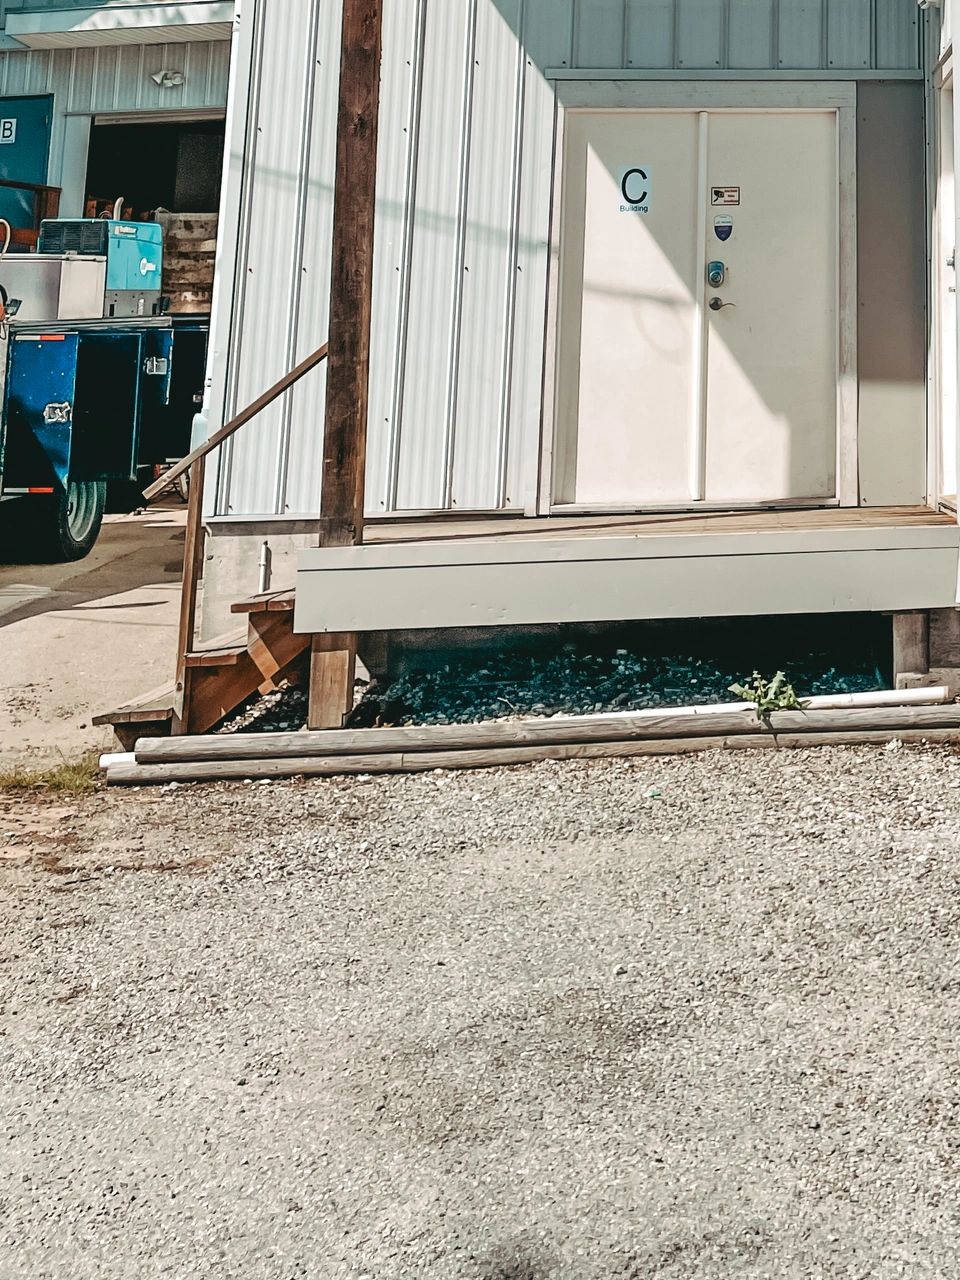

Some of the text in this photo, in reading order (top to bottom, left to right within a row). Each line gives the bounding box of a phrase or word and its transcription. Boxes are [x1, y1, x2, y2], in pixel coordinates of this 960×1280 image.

[2, 121, 13, 138] B
[621, 168, 648, 205] C
[619, 205, 649, 213] Building
